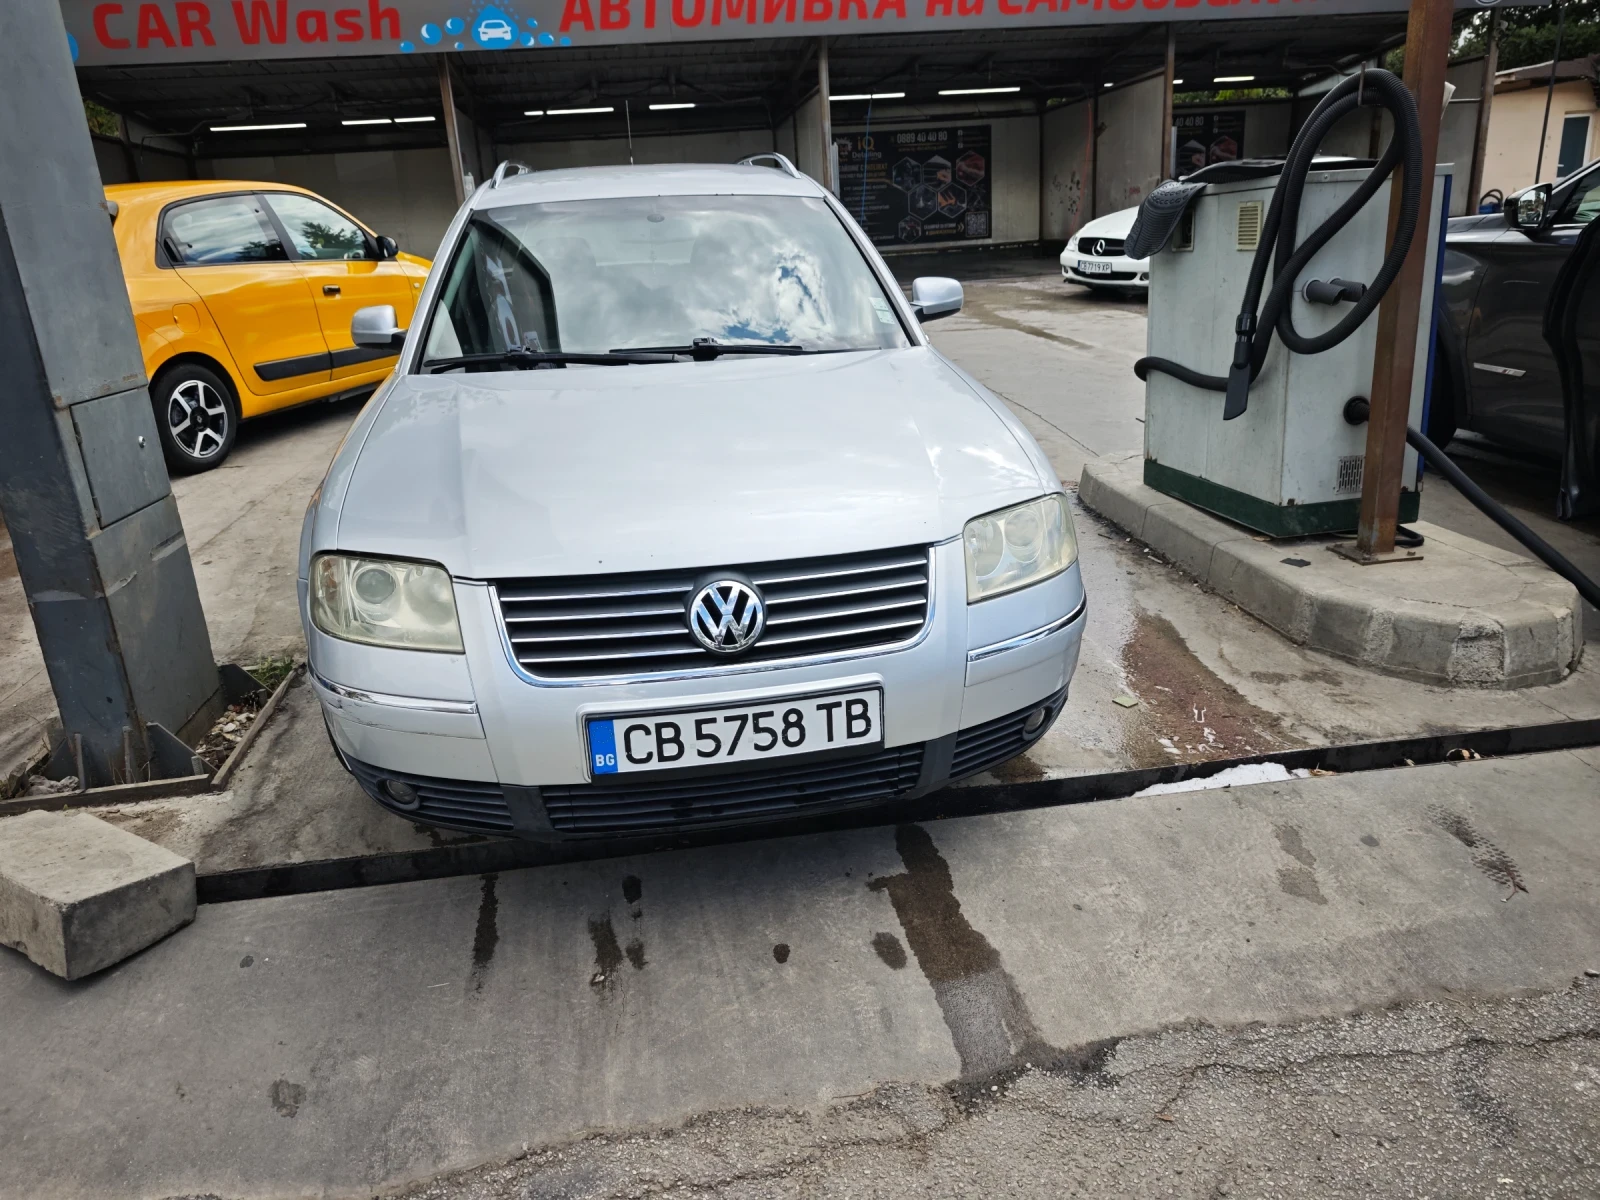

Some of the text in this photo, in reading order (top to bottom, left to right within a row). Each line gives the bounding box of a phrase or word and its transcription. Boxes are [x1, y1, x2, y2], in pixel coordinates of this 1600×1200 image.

[92, 0, 401, 49] CAR Wash
[857, 136, 875, 151] iQ
[897, 132, 915, 144] 0889
[917, 131, 927, 142] 40
[928, 131, 937, 142] 40
[938, 130, 948, 141] 80
[623, 698, 872, 765] CB 5758 TB
[595, 753, 615, 767] BG
